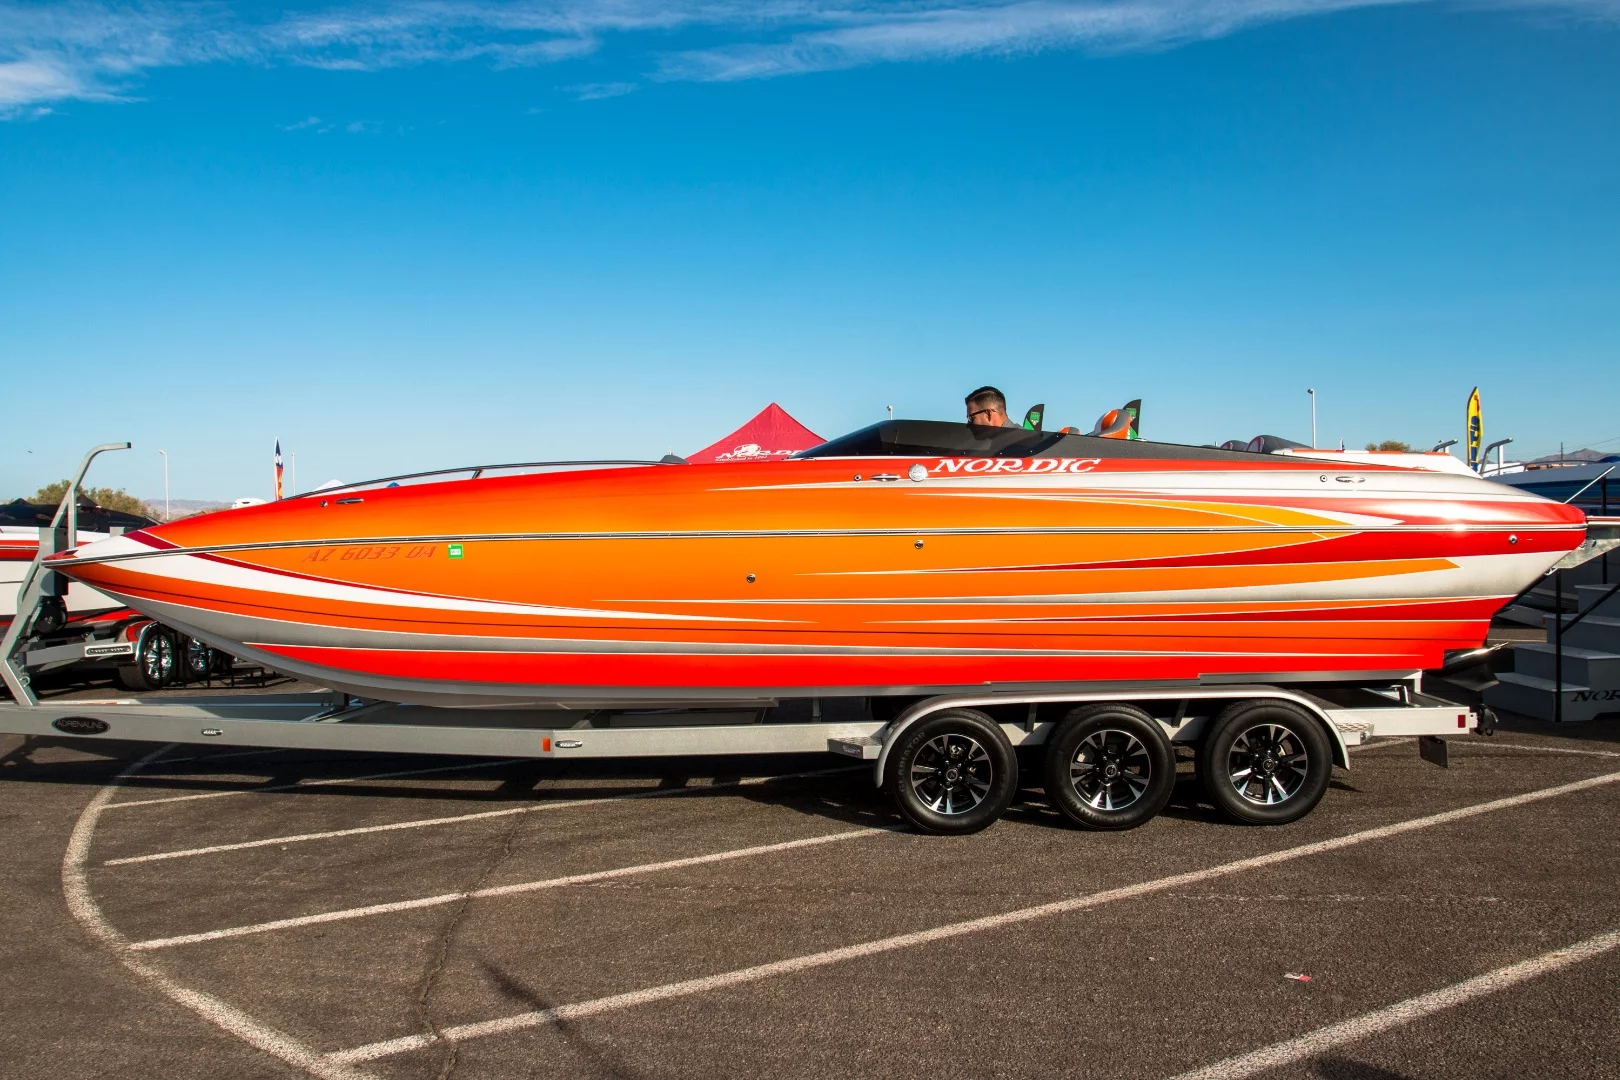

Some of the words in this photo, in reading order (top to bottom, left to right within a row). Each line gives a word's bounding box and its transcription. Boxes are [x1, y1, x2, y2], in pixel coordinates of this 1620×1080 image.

[928, 458, 1101, 473] NORDIC
[303, 548, 338, 562] AZ
[340, 546, 401, 561] 6033
[58, 720, 104, 729] ADRENALINE
